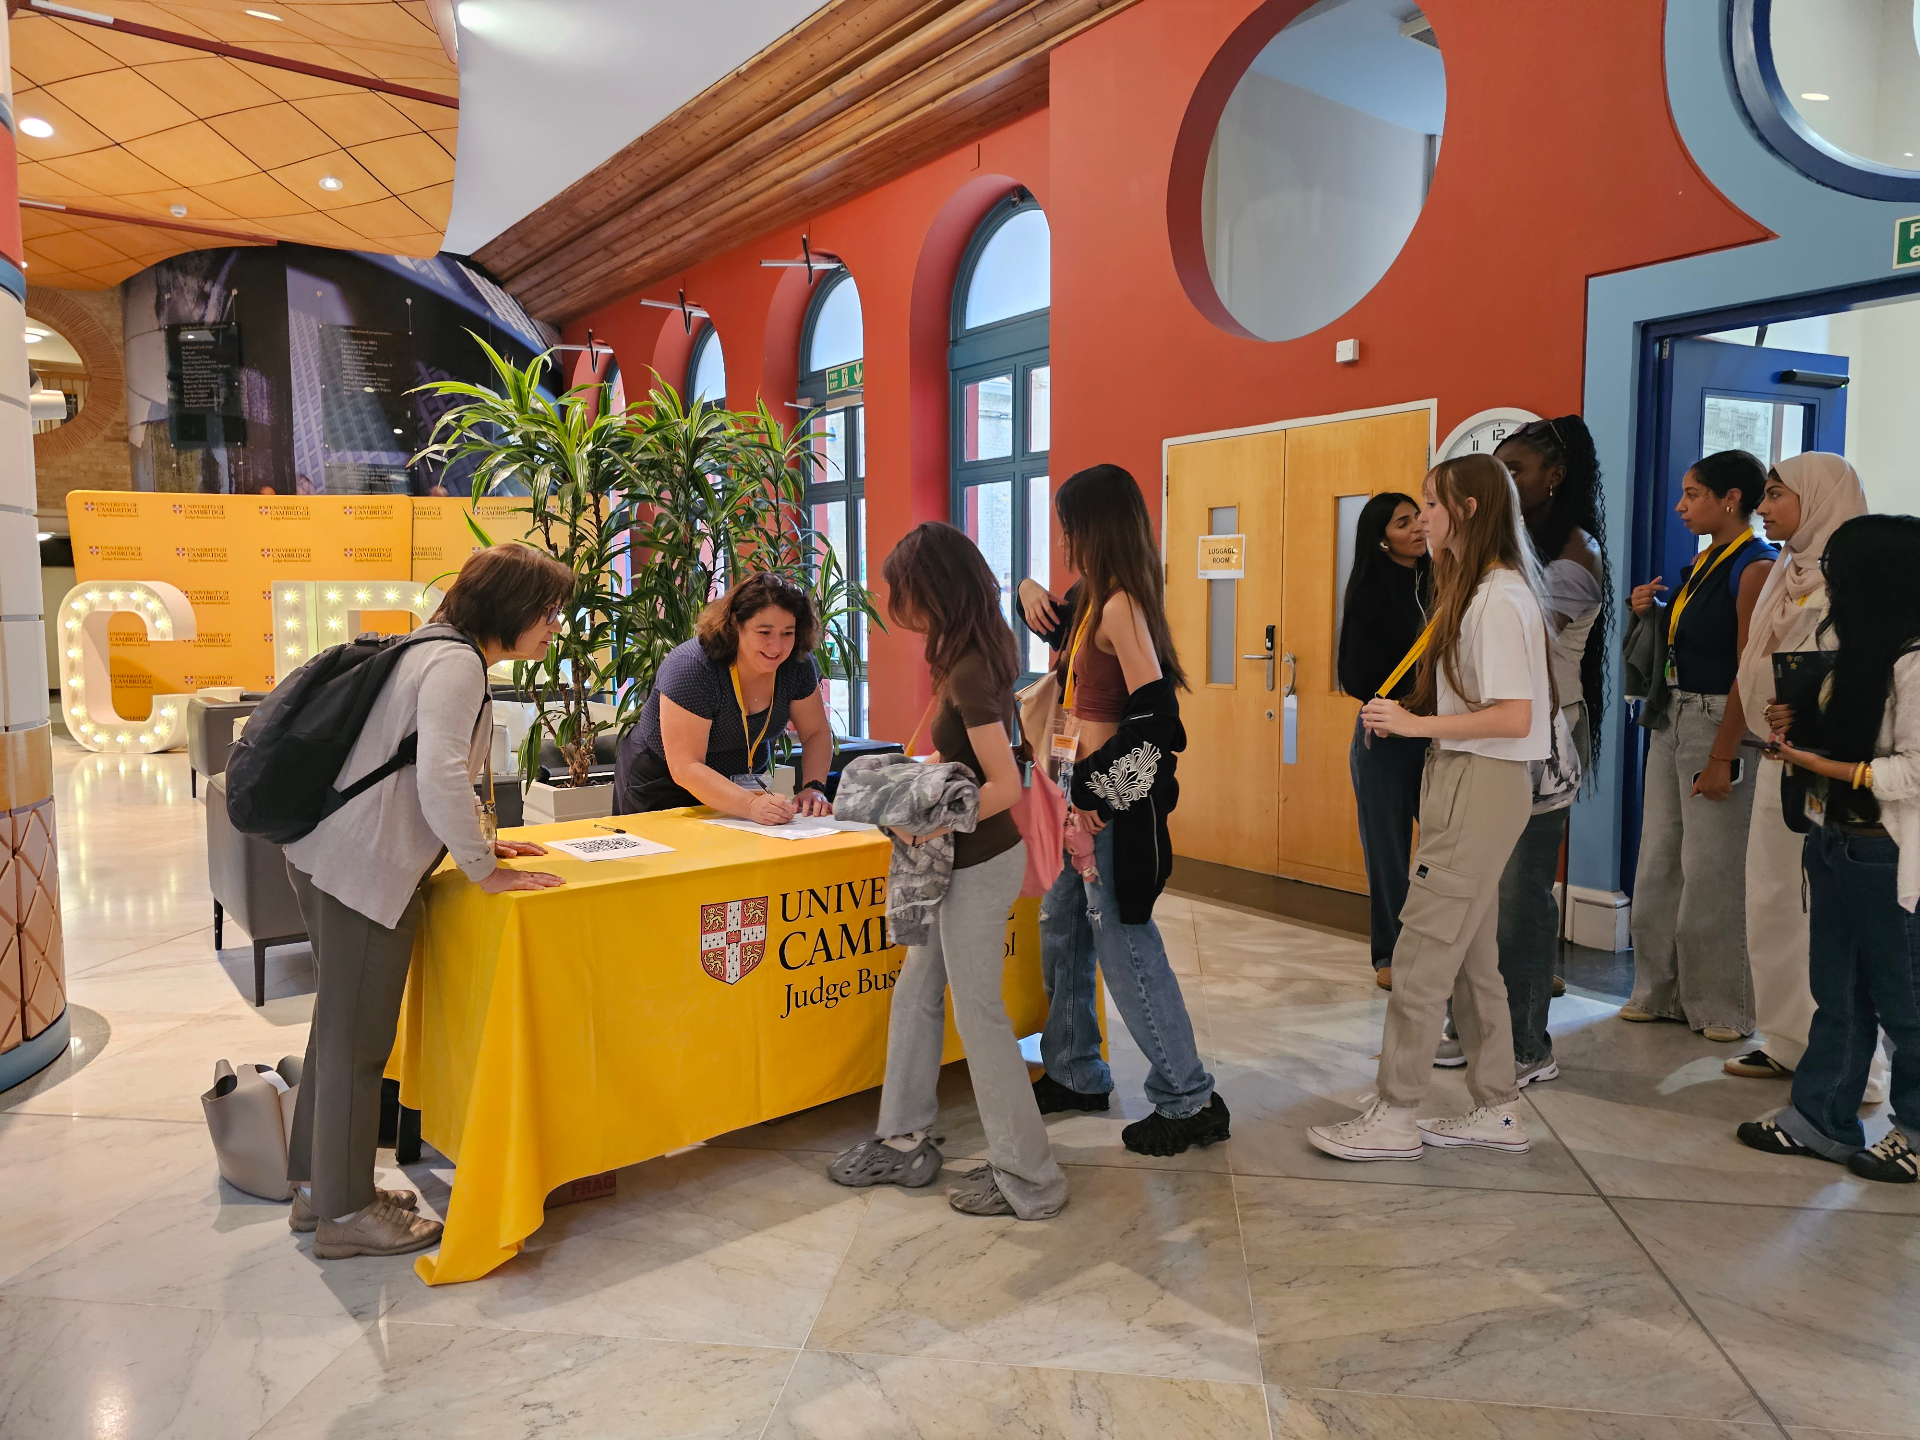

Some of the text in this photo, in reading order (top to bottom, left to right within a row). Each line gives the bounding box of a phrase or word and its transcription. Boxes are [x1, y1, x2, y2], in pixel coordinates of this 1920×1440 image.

[829, 380, 839, 389] EXIT
[1492, 428, 1506, 441] 12
[1472, 440, 1479, 451] 11
[780, 975, 851, 1018] Judge
